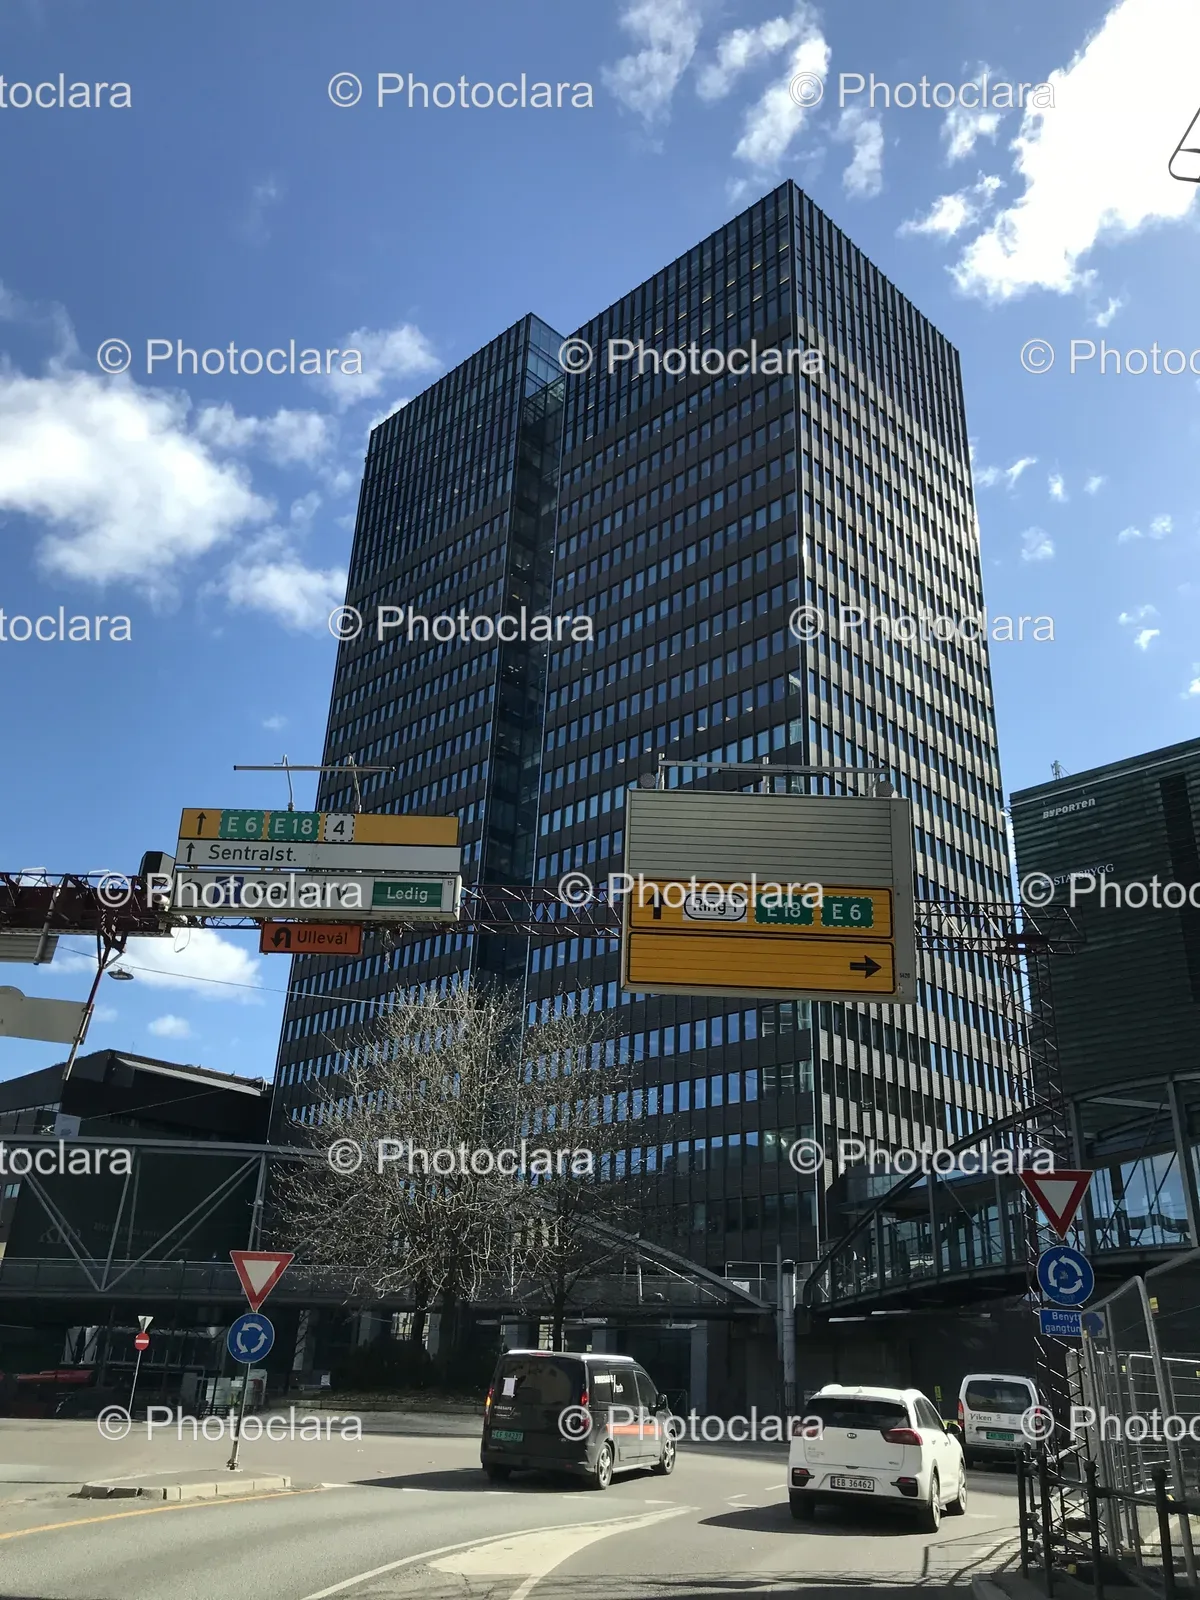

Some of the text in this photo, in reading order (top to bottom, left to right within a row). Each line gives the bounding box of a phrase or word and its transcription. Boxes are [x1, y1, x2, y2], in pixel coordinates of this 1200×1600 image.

[333, 820, 345, 835] 4
[208, 845, 297, 862] Sentralst.
[1054, 863, 1115, 886] STASBYGG
[386, 886, 428, 903] Ledig
[1045, 1324, 1088, 1335] gangtun
[836, 1479, 872, 1489] EB 36462
